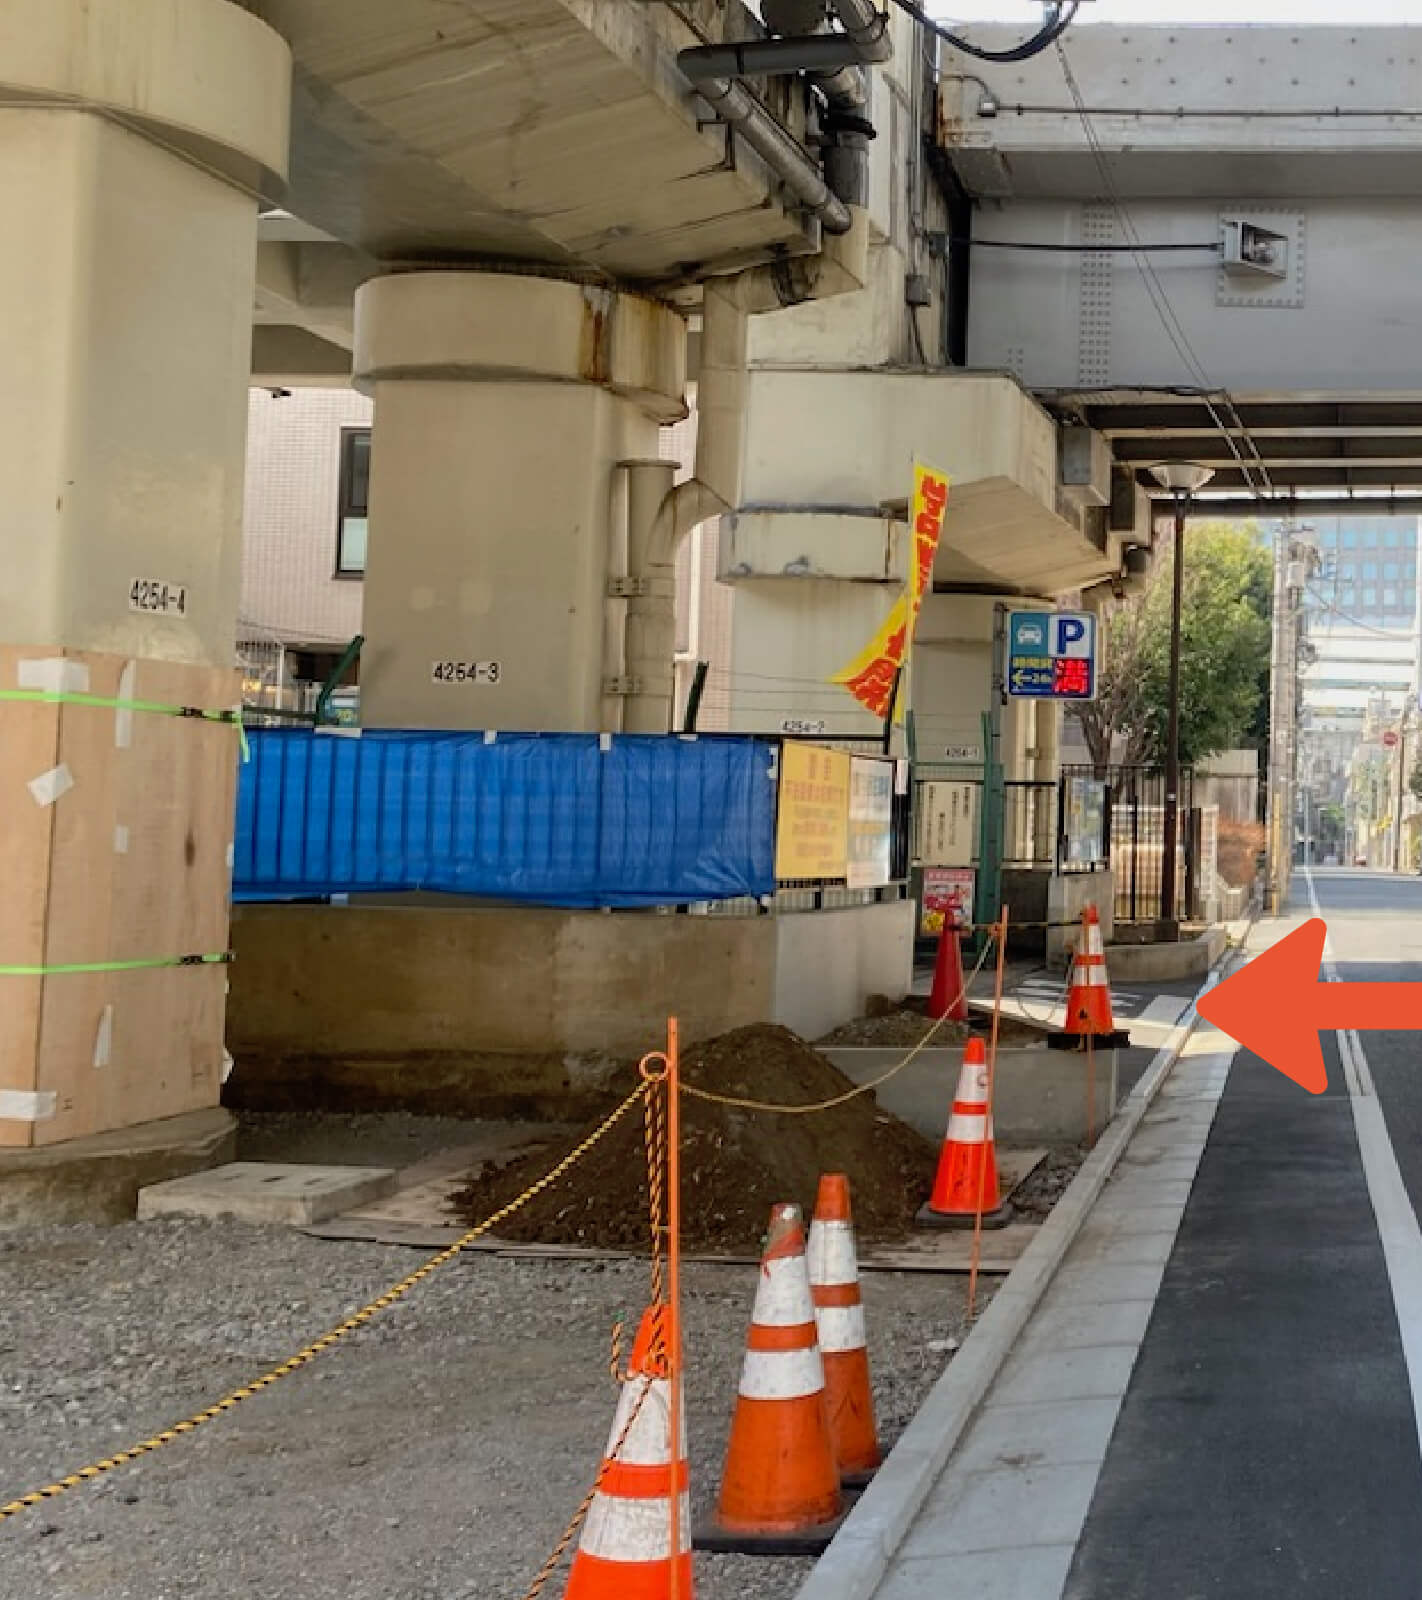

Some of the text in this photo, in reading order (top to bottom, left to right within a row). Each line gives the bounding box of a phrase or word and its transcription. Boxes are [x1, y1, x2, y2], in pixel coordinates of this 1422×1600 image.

[130, 580, 185, 613] 4254-4
[1057, 620, 1084, 654] P
[434, 663, 498, 682] 4254-3
